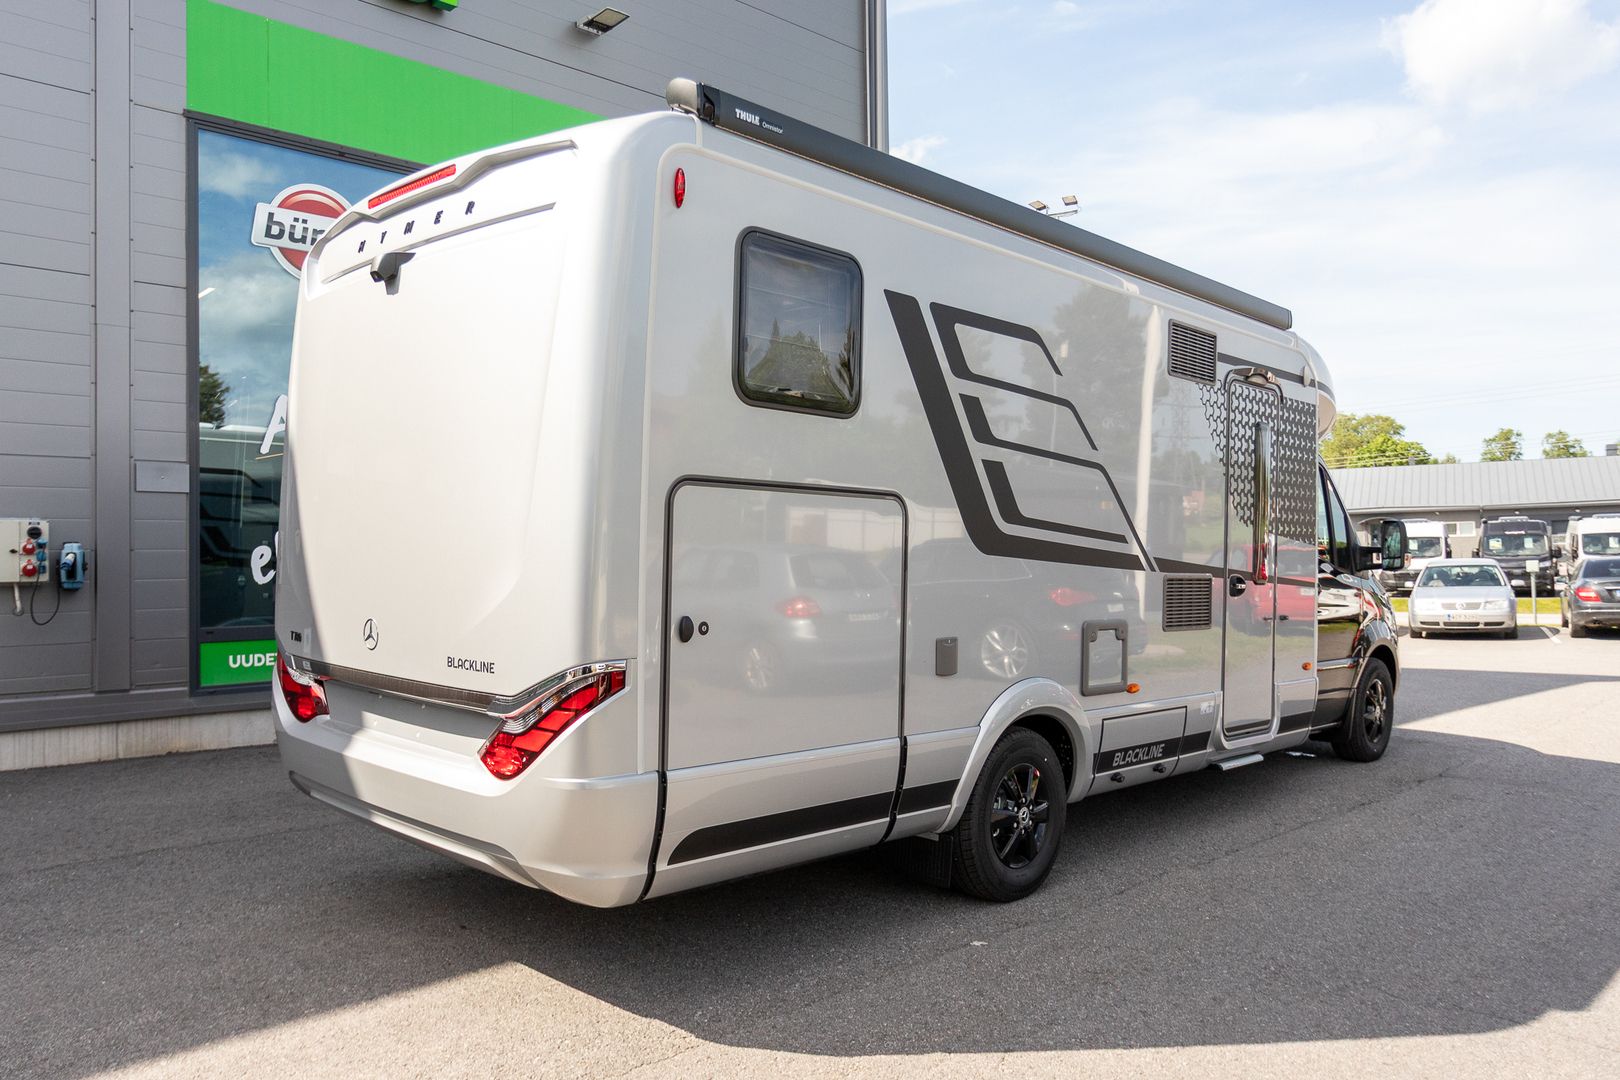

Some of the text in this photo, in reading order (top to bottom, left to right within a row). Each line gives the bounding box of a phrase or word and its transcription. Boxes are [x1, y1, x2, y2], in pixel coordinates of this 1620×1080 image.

[735, 108, 760, 126] THULE
[447, 656, 495, 674] BLACKLINE
[1112, 743, 1166, 767] BLACKLINE
